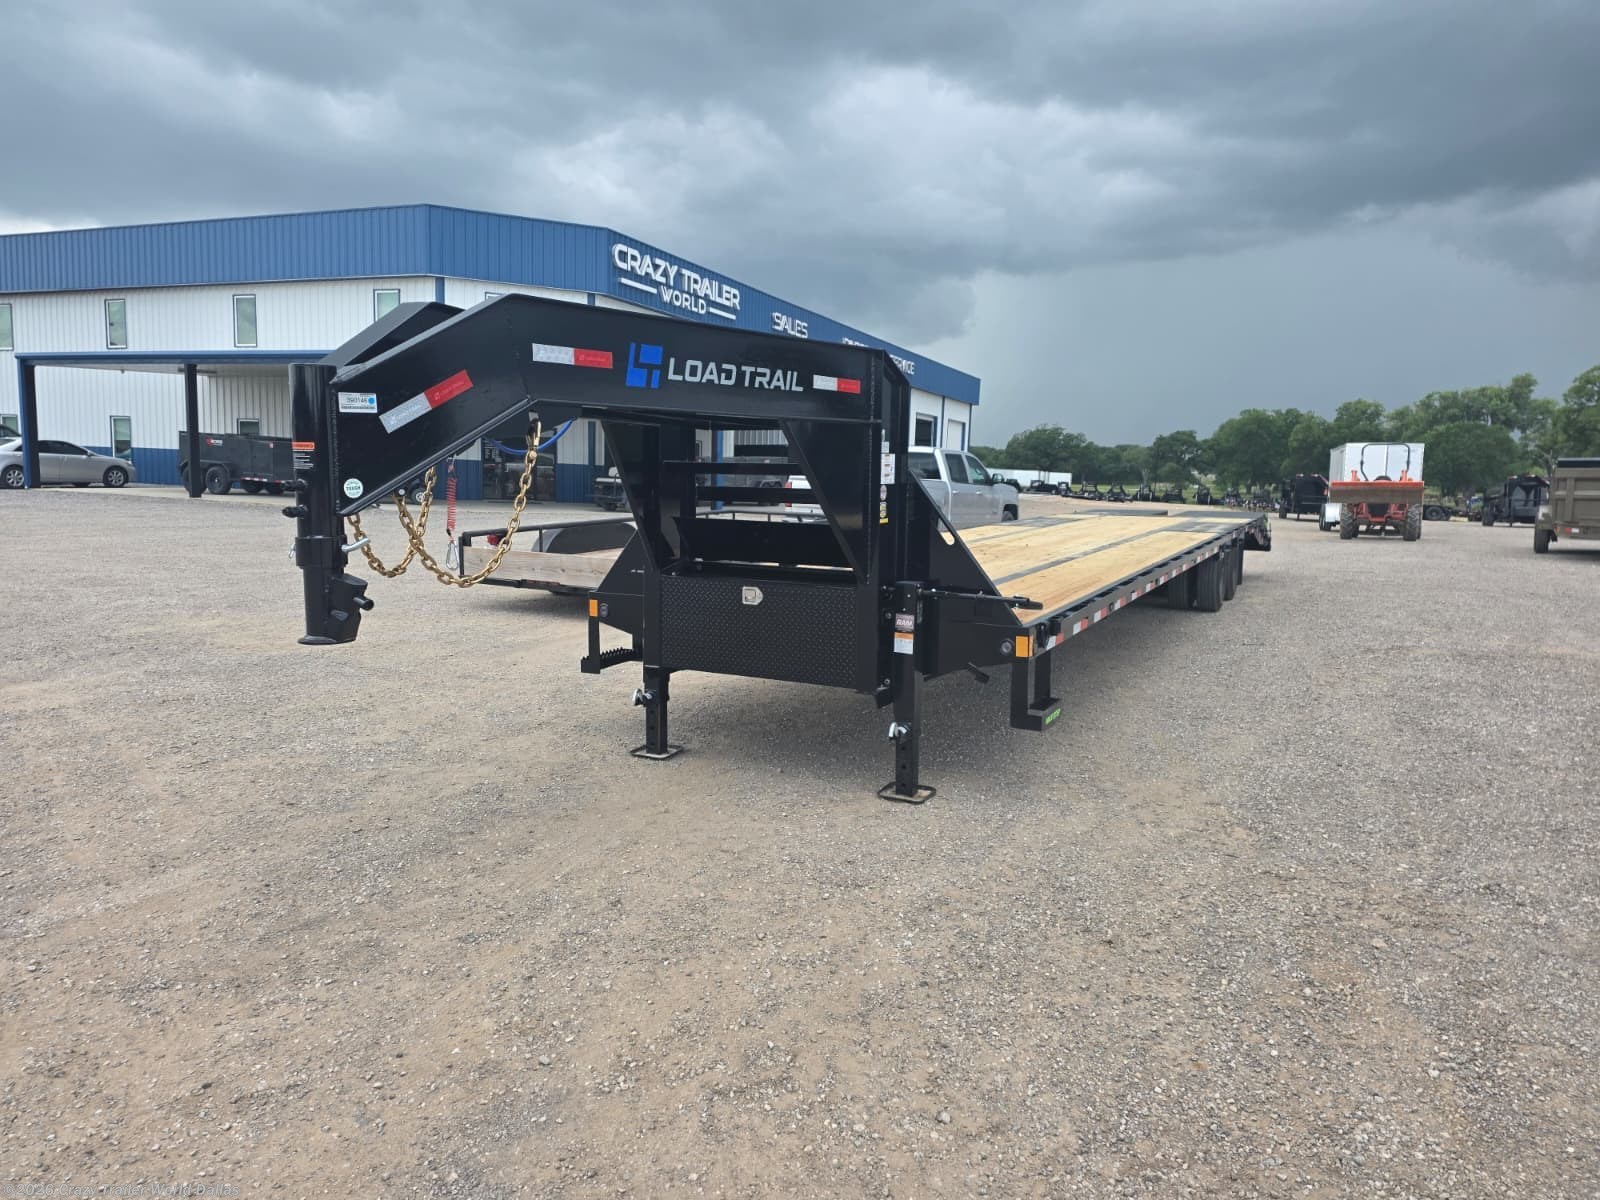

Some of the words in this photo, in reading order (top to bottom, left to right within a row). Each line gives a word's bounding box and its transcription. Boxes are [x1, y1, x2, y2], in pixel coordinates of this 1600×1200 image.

[612, 243, 678, 286] CRAZY
[680, 267, 740, 310] TRAILER
[660, 285, 707, 315] WORLD
[771, 311, 808, 339] SALES
[667, 357, 737, 386] LOAD
[741, 365, 804, 392] TRAIL
